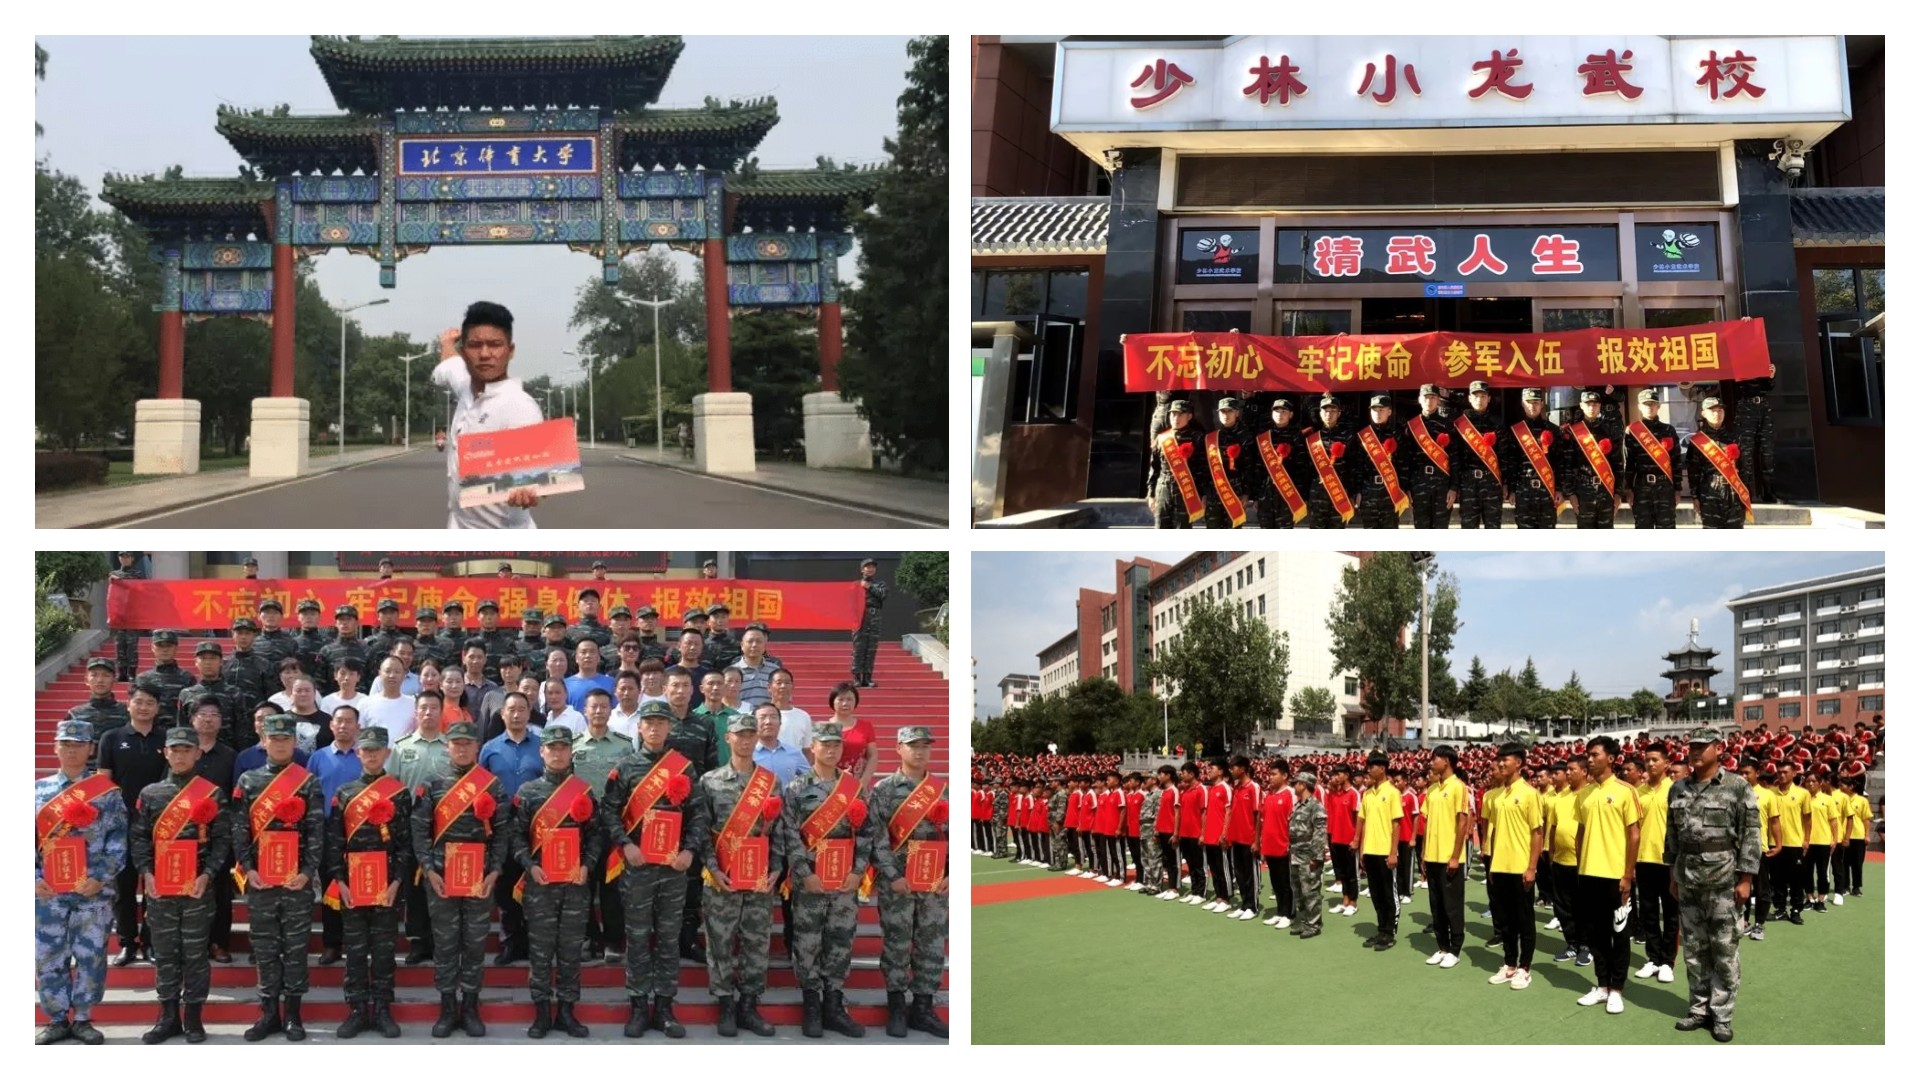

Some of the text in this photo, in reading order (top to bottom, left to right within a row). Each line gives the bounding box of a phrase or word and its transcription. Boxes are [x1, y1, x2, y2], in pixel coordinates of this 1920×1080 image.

[1129, 49, 1769, 111] 少林小龙武校
[420, 143, 574, 171] 北京体育大学
[1313, 234, 1584, 277] 精武人生
[1145, 332, 1720, 381] 不忘初心 牢记使命 参军入伍 报效祖国
[650, 586, 783, 621] 报效祖国
